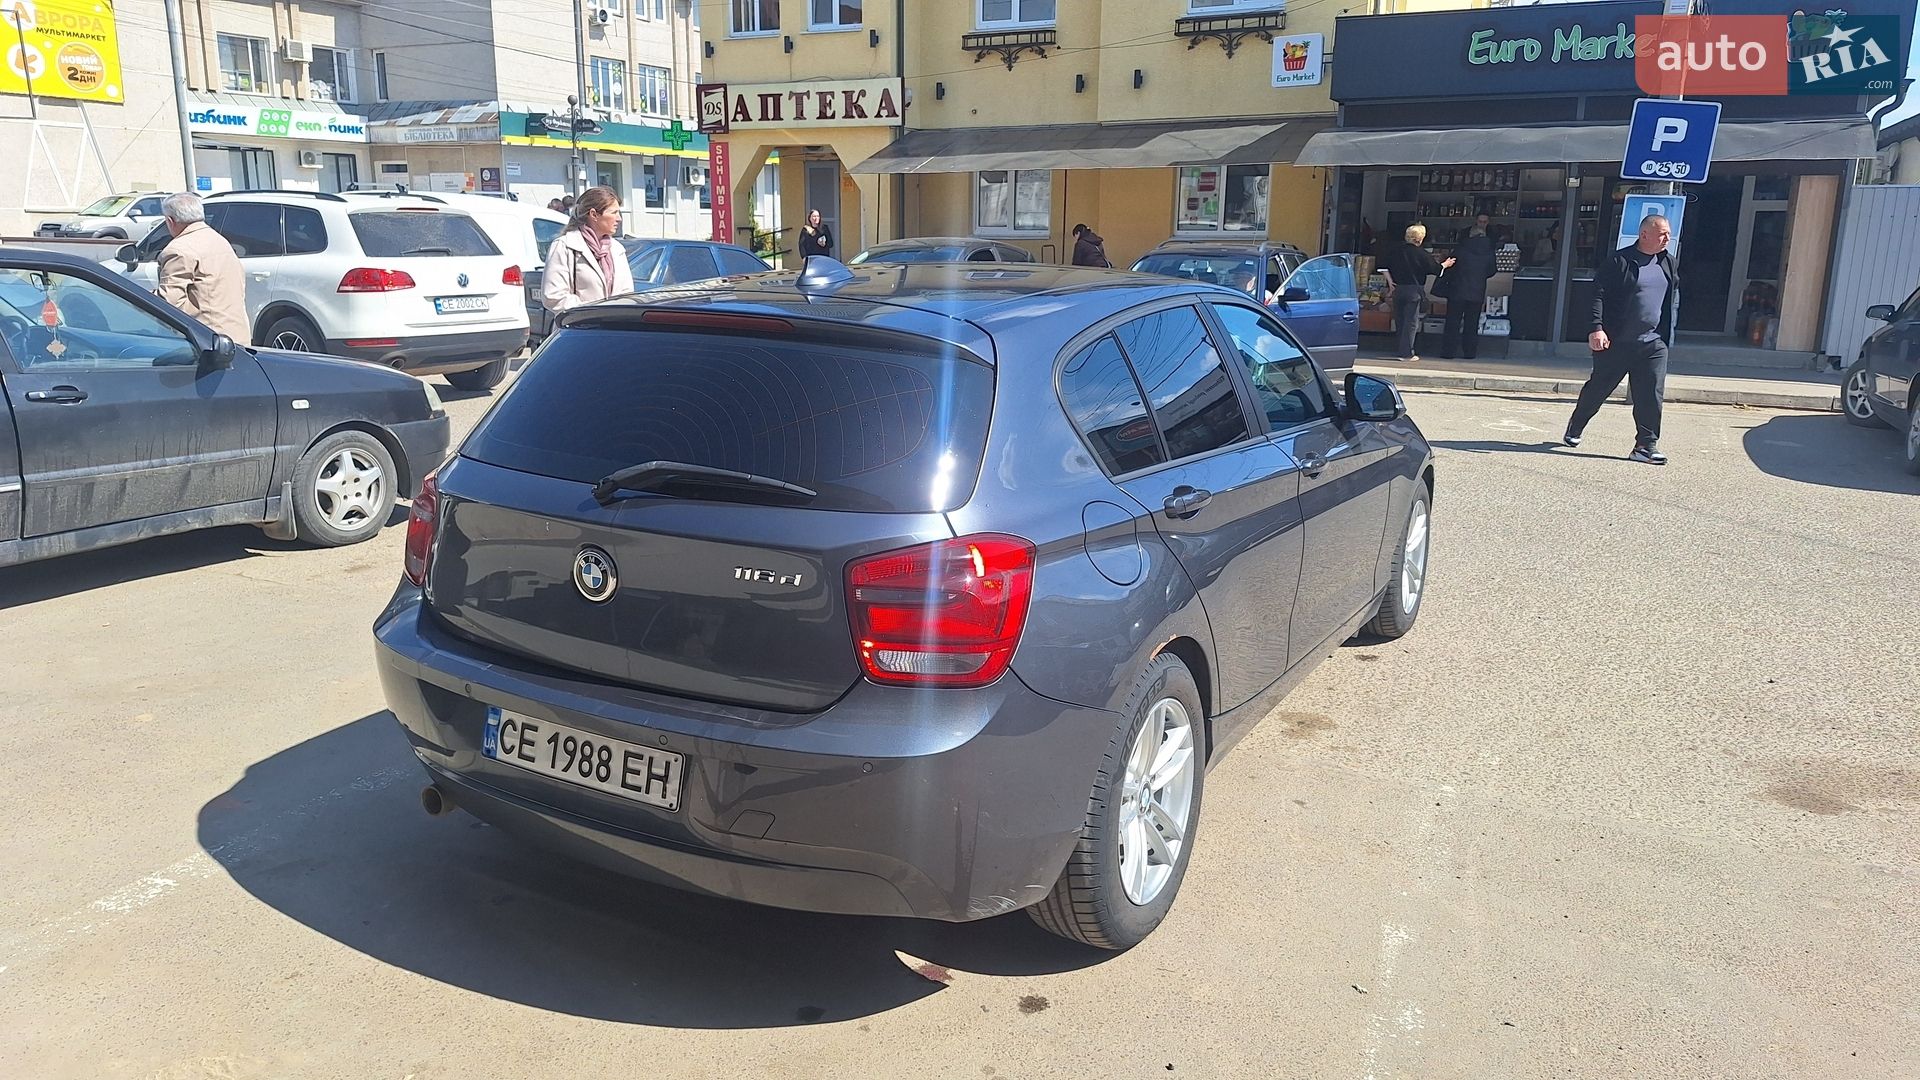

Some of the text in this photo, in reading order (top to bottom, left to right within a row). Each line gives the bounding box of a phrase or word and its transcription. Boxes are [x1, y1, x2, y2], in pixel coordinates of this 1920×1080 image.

[10, 1, 105, 34] АВРОРА
[35, 26, 107, 42] МУЛЬТИМАРКЕТ
[1468, 22, 1659, 65] Euro Marke
[60, 53, 98, 65] НОВИЙ
[67, 66, 96, 83] 2 ДНІ
[1277, 72, 1316, 83] Euro Market
[731, 87, 900, 123] АПТЕКА
[404, 131, 454, 141] БІБЛІОТЕКА
[1651, 117, 1688, 151] P
[715, 145, 726, 205] SCHIMB
[1658, 162, 1671, 173] 25
[1674, 164, 1687, 175] 50
[484, 736, 497, 751] UA
[499, 718, 671, 800] CE 1988 EH
